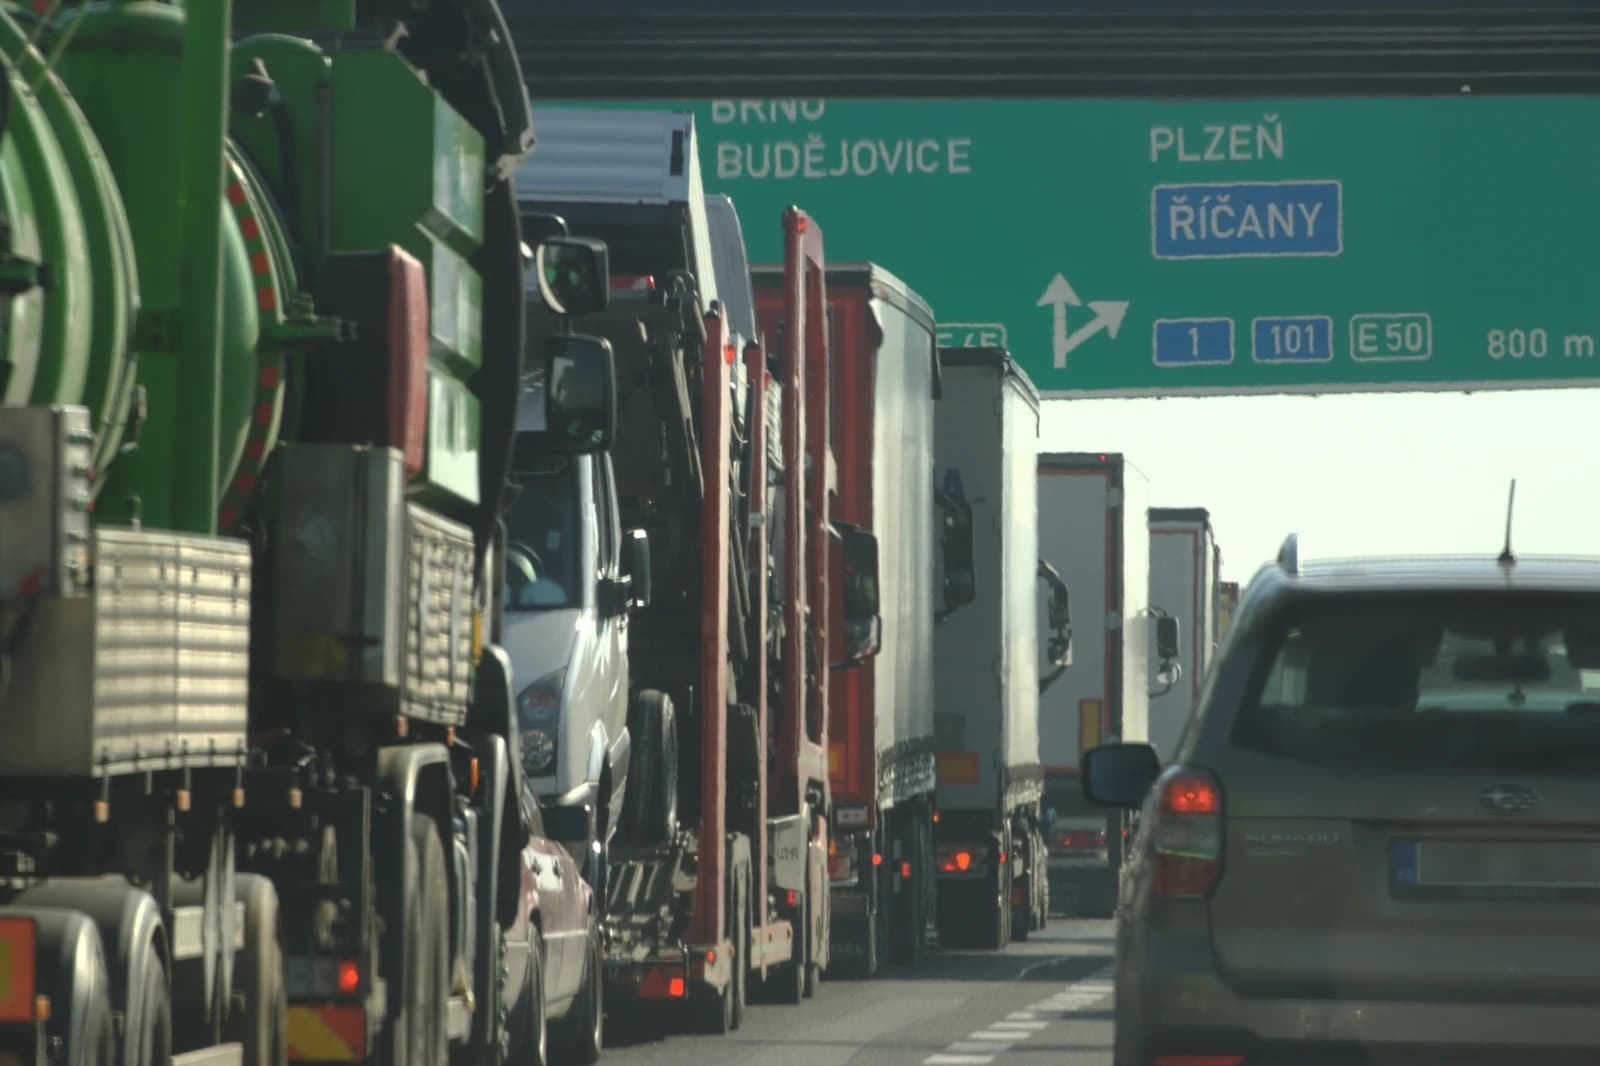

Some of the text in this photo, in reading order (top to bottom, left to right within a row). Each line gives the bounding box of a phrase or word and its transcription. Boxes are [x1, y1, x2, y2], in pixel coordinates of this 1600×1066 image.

[1150, 113, 1285, 162] PLZEŇ
[717, 133, 971, 179] BUDĚJOVICE
[1169, 195, 1324, 241] ŘÍČANY
[1187, 327, 1200, 356] 1
[1270, 324, 1316, 353] 101
[1358, 322, 1423, 352] E 50
[1487, 328, 1595, 358] 800 m
